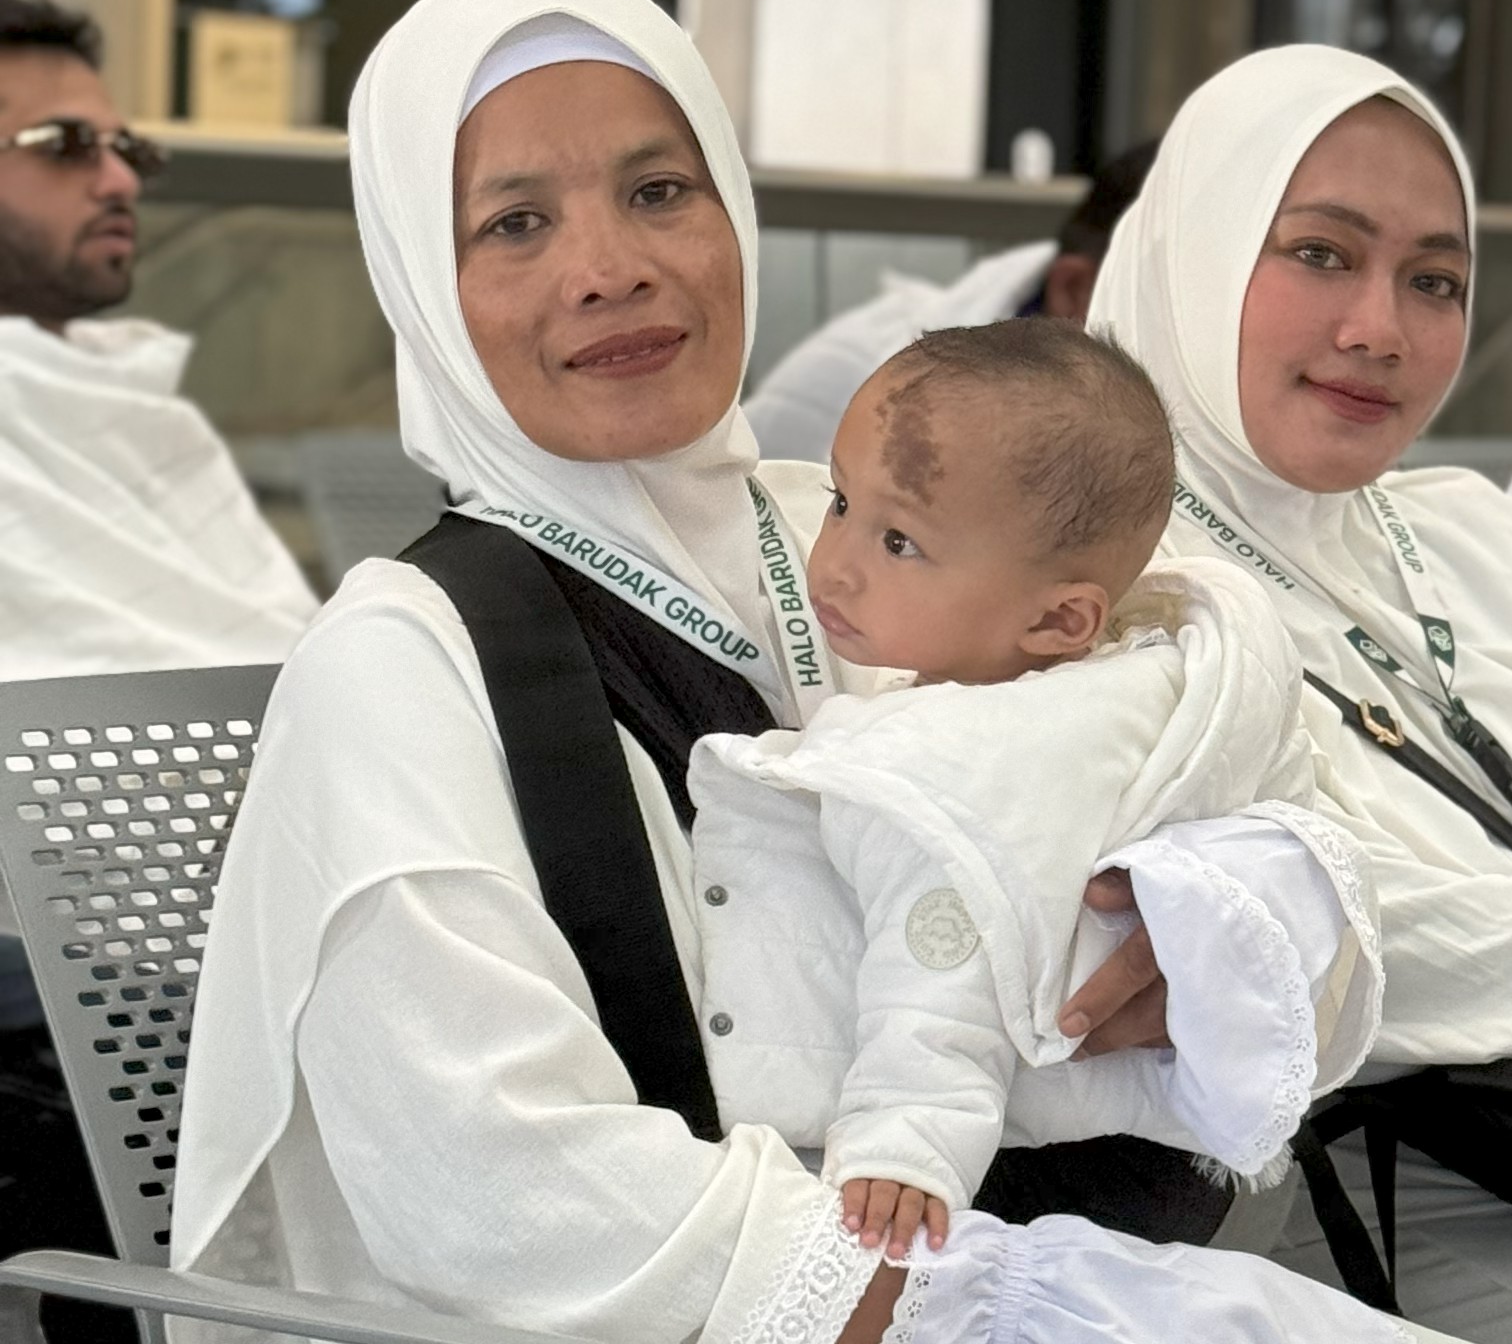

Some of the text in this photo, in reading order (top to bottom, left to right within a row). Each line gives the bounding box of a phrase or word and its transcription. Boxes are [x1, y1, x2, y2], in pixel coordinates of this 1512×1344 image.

[758, 511, 803, 612] BARUDAK
[1236, 543, 1295, 590] HALO
[1387, 522, 1424, 574] GROUP
[537, 522, 760, 662] BARUDAK GROUP
[786, 618, 822, 686] HALO
